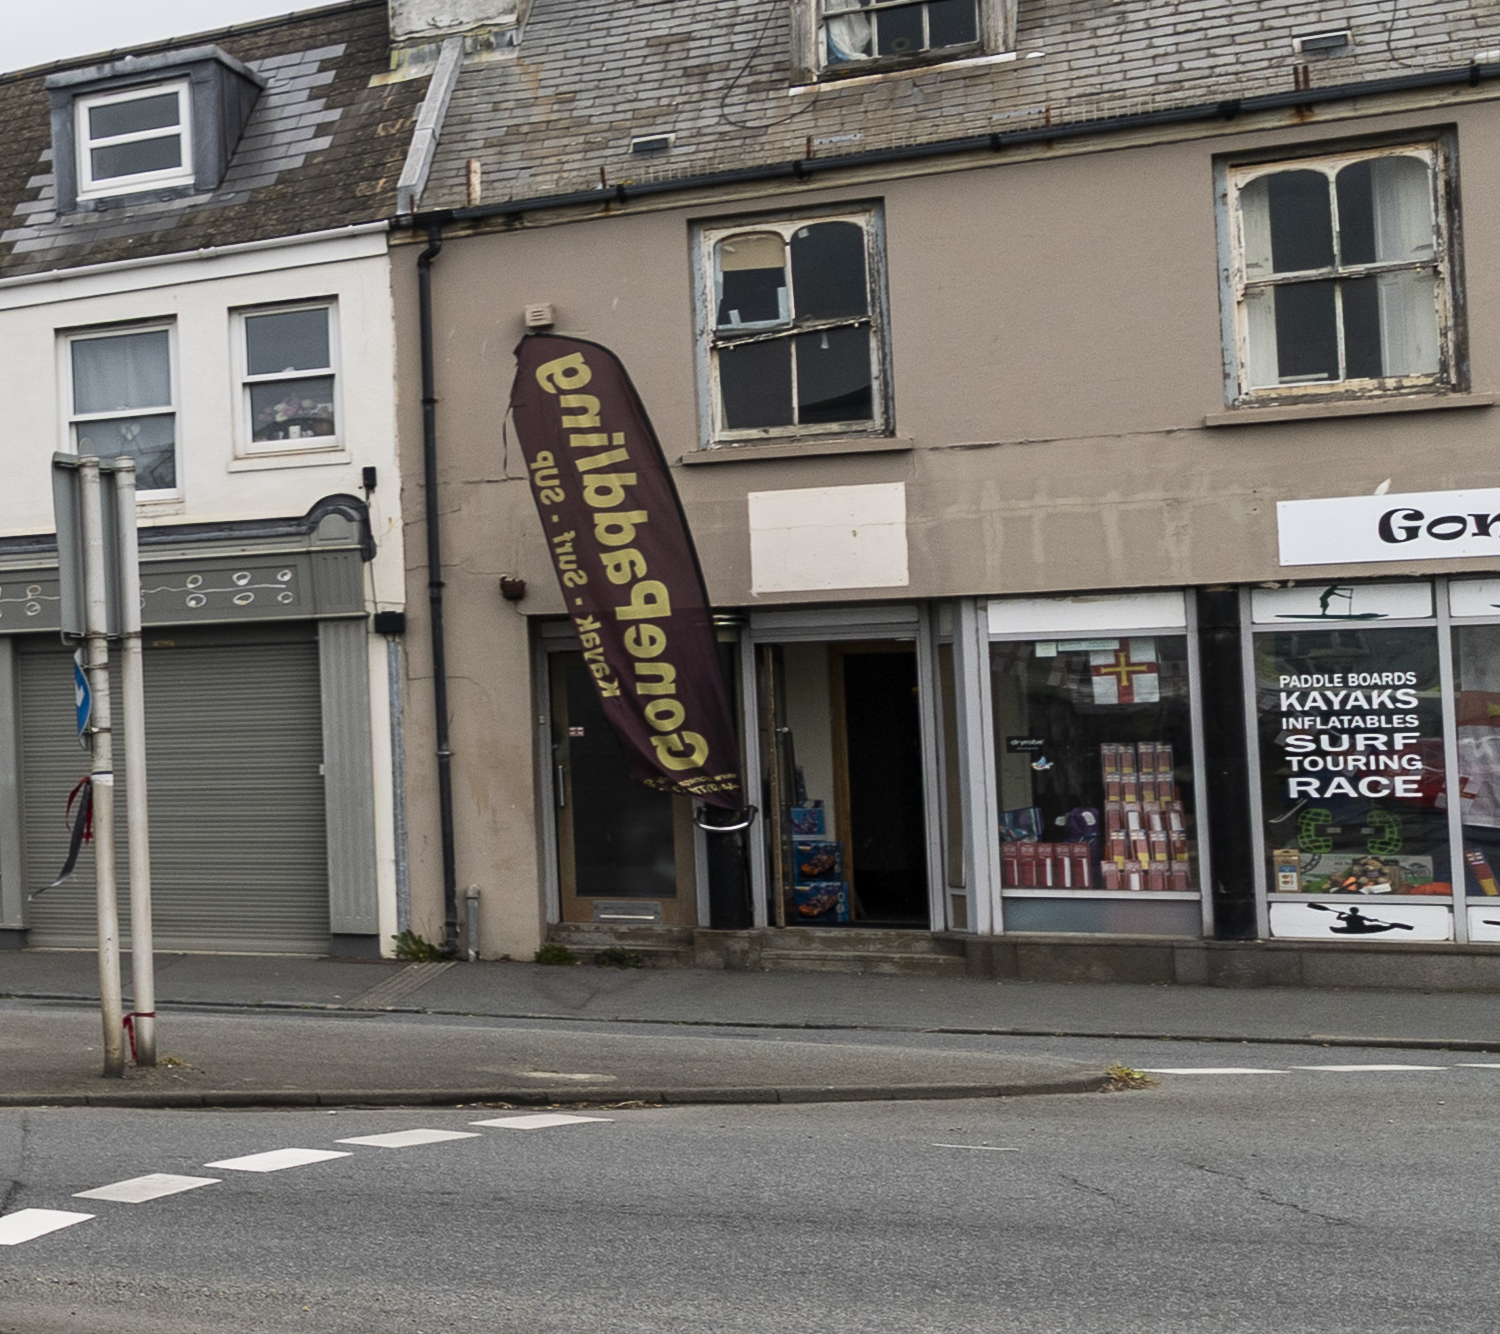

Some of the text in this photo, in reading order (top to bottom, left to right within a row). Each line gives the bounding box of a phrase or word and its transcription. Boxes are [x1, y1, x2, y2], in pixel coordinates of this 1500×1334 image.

[1279, 671, 1417, 688] PADDLE BOARDS
[1280, 688, 1419, 711] KAYAKS
[1282, 714, 1420, 730] INFLATABLES
[1284, 732, 1421, 753] SURF
[1285, 754, 1423, 771] TOURING
[1288, 775, 1423, 799] RACE
